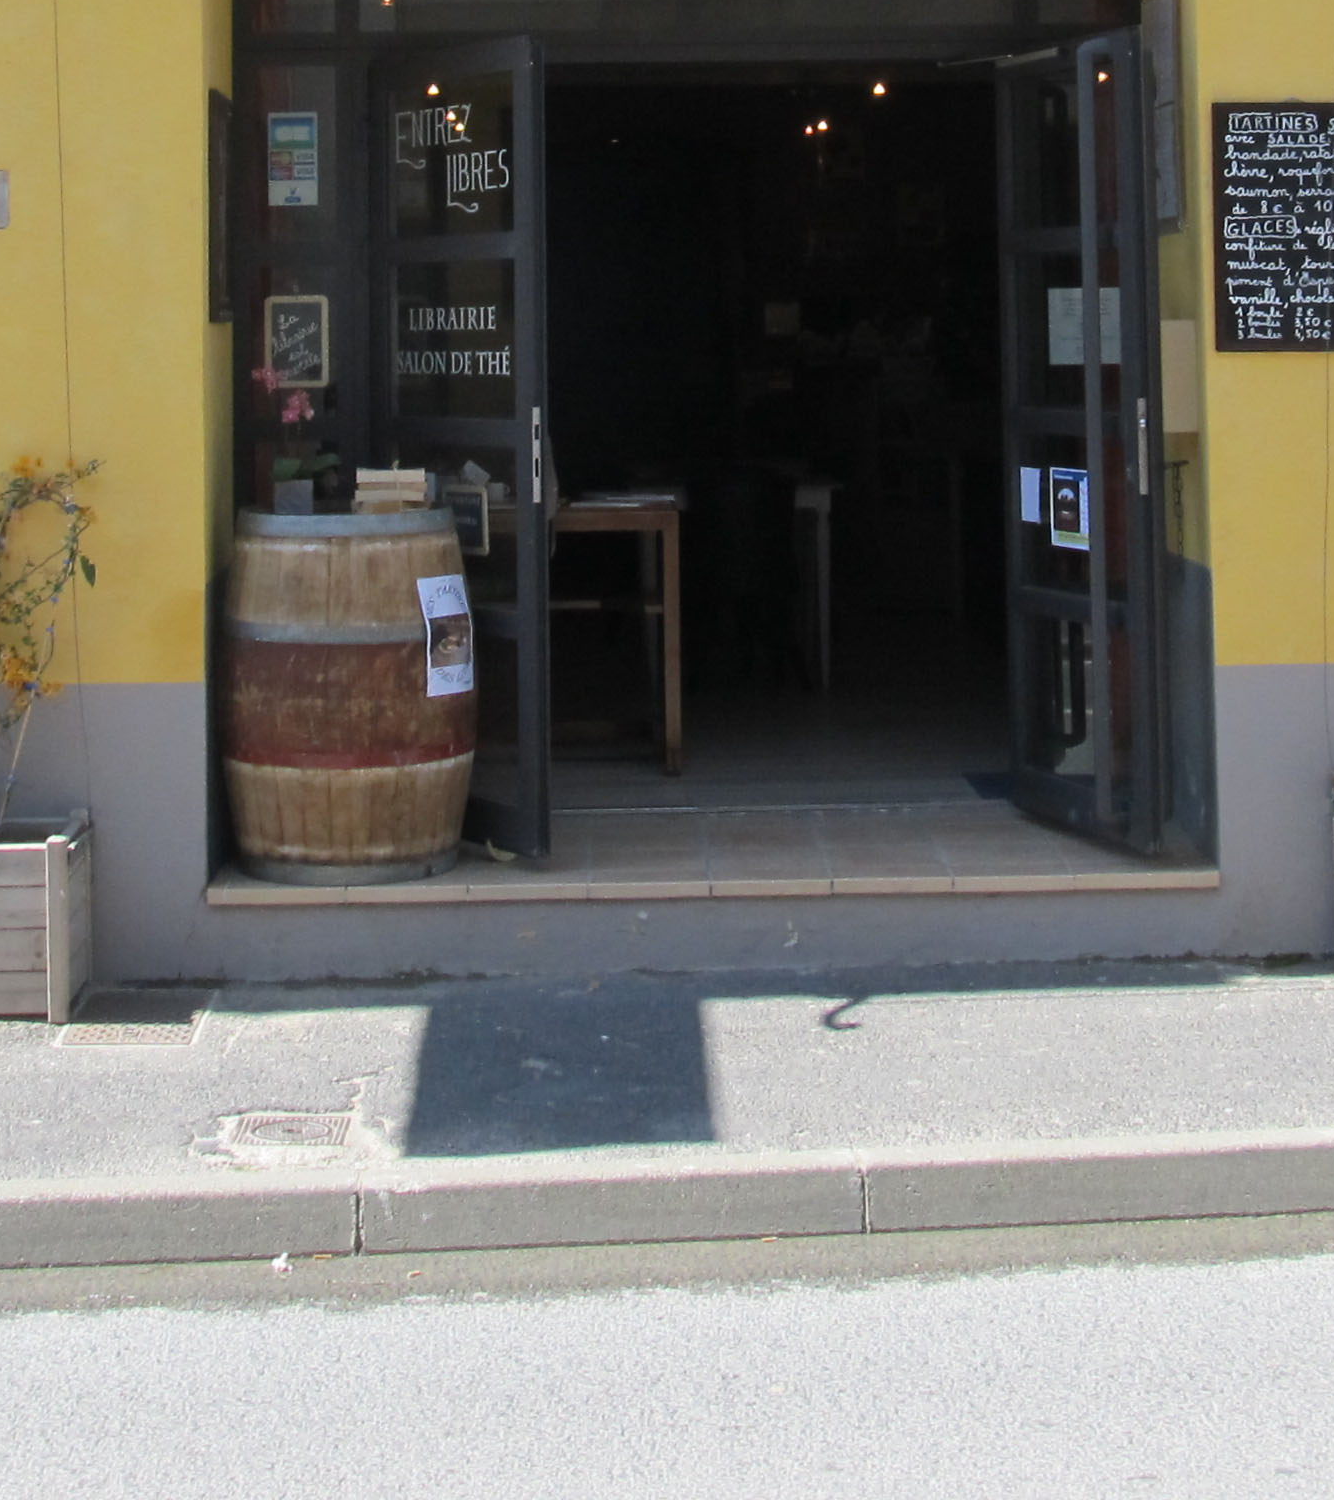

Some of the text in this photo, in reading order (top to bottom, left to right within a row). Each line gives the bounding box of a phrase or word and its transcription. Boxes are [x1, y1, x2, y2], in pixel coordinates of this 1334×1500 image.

[1233, 115, 1314, 131] TARTINES
[395, 103, 473, 170] ENTREZ
[1224, 133, 1256, 144] avec
[446, 148, 510, 213] LIBRES
[1232, 202, 1248, 214] de
[1224, 237, 1287, 261] confiture
[1292, 239, 1308, 251] de
[409, 305, 497, 332] LIBRAIRIE
[1234, 307, 1244, 318] 1
[1237, 318, 1246, 329] 2
[396, 344, 511, 376] SALON DE THÉ
